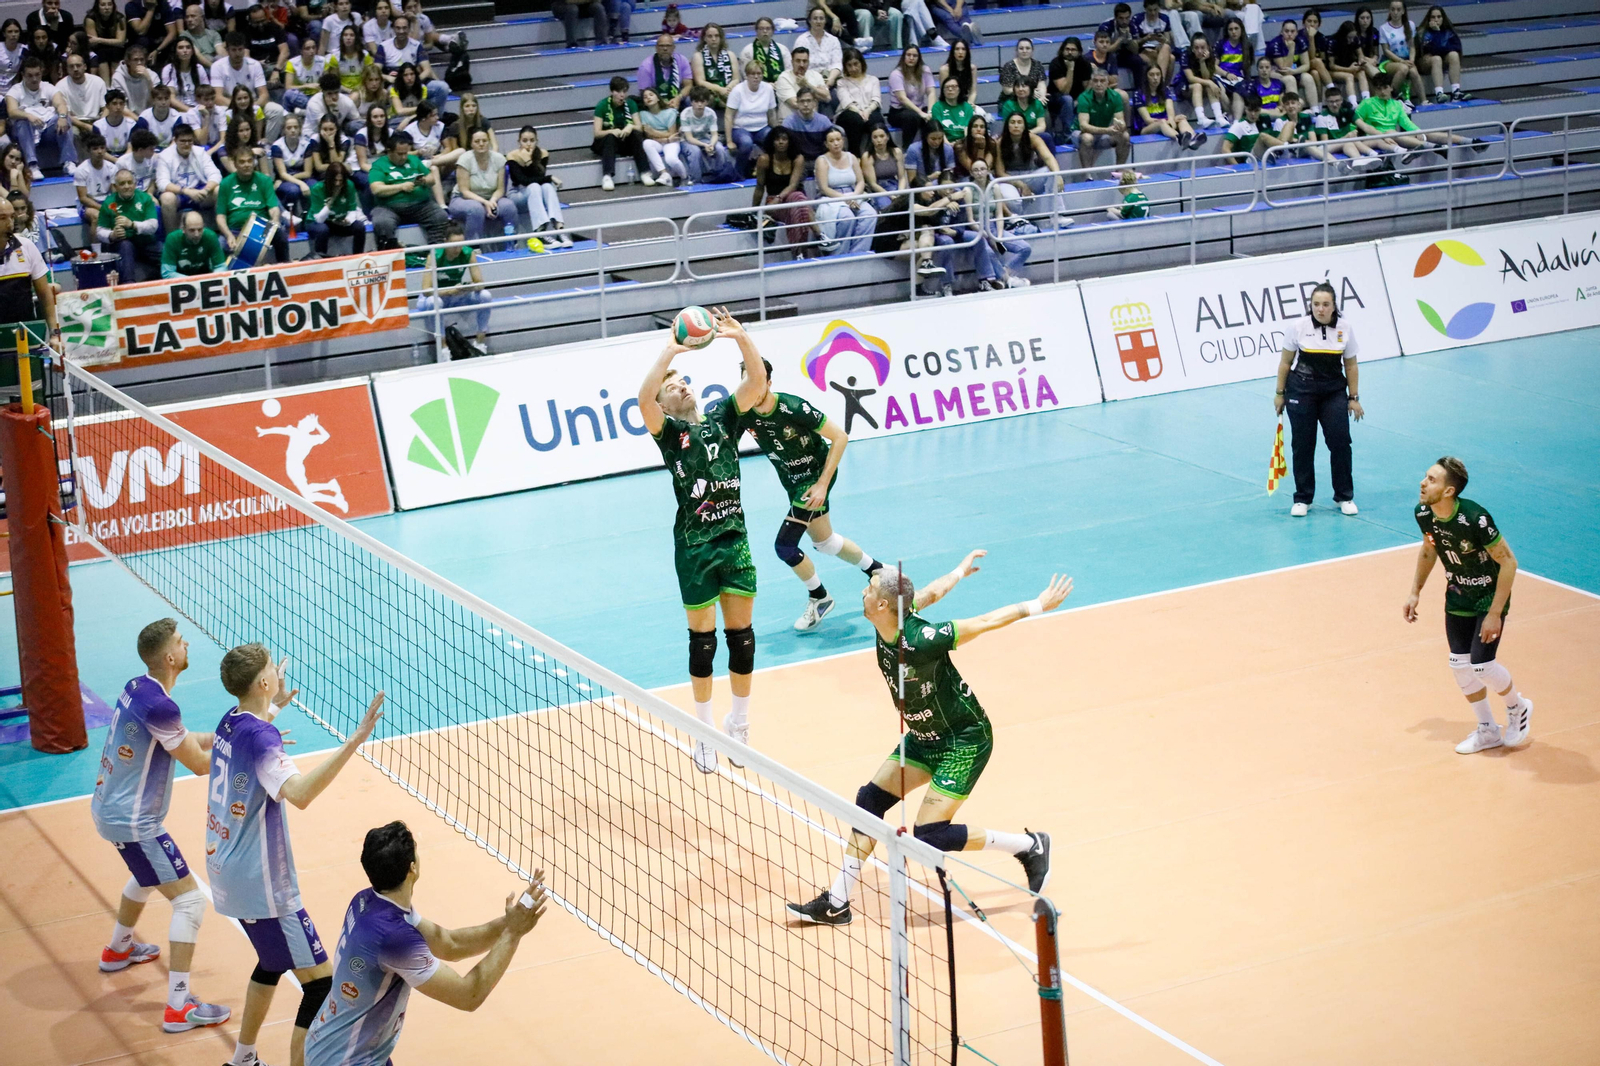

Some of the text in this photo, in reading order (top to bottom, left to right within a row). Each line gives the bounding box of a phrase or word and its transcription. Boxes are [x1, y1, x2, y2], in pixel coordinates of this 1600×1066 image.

[96, 184, 102, 193] 2
[1140, 206, 1149, 218] 7
[1498, 230, 1600, 285] Andalucí
[170, 270, 289, 314] PEÑA
[350, 279, 361, 287] LA
[125, 298, 339, 356] LA UNION
[904, 337, 1046, 379] COSTA DE
[885, 367, 1059, 430] ALMERÍA
[121, 507, 196, 536] VOLEIBOL
[198, 493, 288, 525] MASCULINA
[1445, 550, 1462, 566] 10
[1455, 575, 1492, 588] Unicaja
[210, 756, 229, 807] 21
